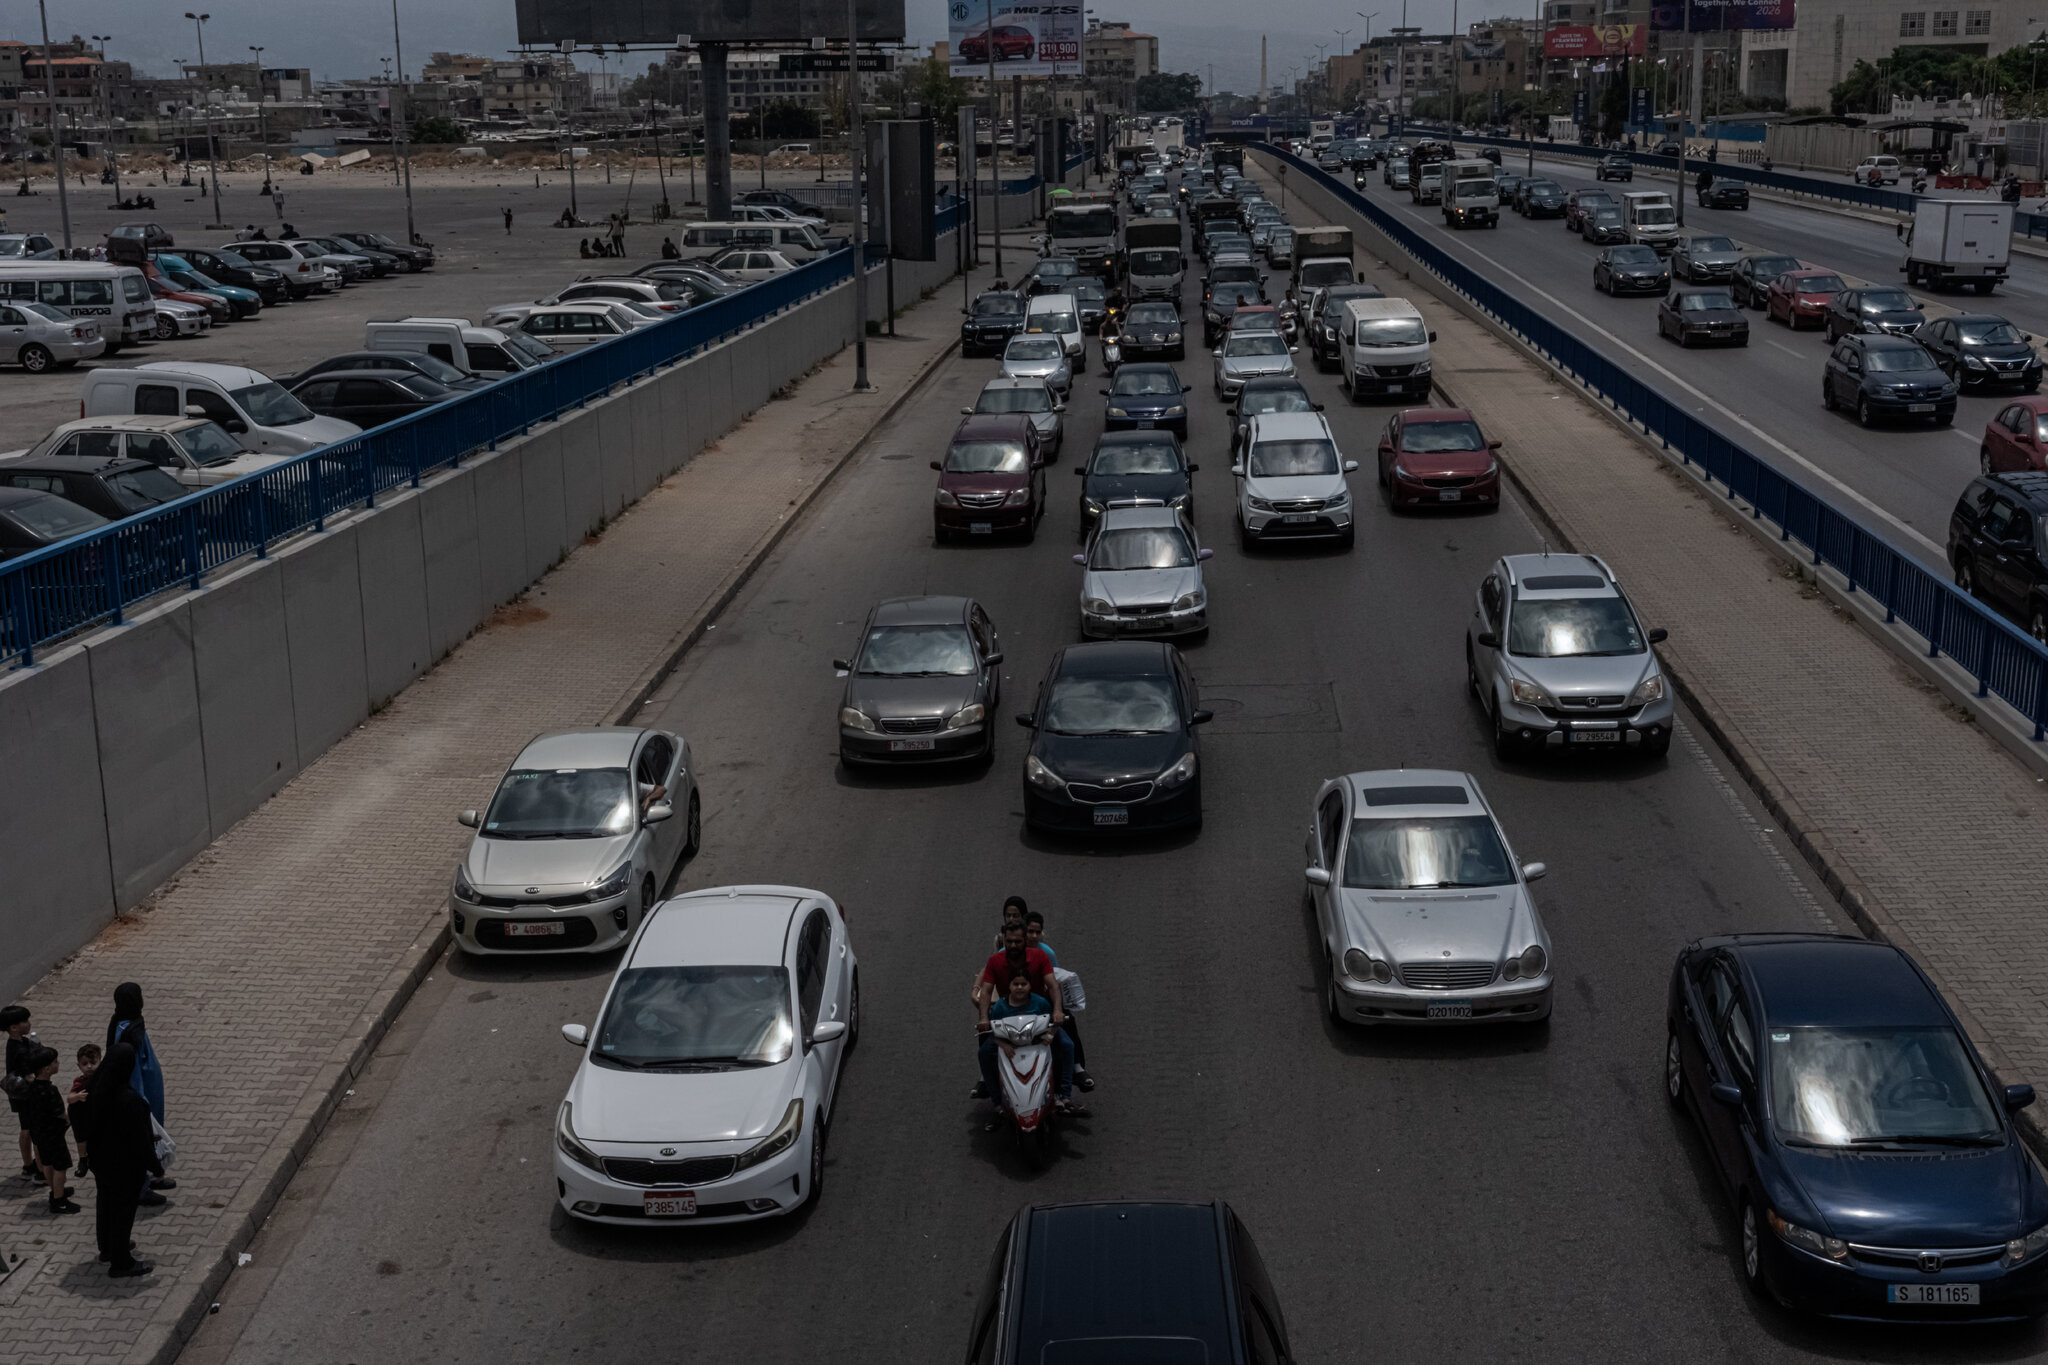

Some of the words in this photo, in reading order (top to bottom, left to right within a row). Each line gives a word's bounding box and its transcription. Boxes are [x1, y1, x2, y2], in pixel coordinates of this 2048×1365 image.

[952, 3, 968, 21] MG
[1756, 6, 1781, 15] 2026
[511, 925, 518, 934] P
[1899, 1286, 1909, 1301] S
[1918, 1286, 1969, 1302] 181165
